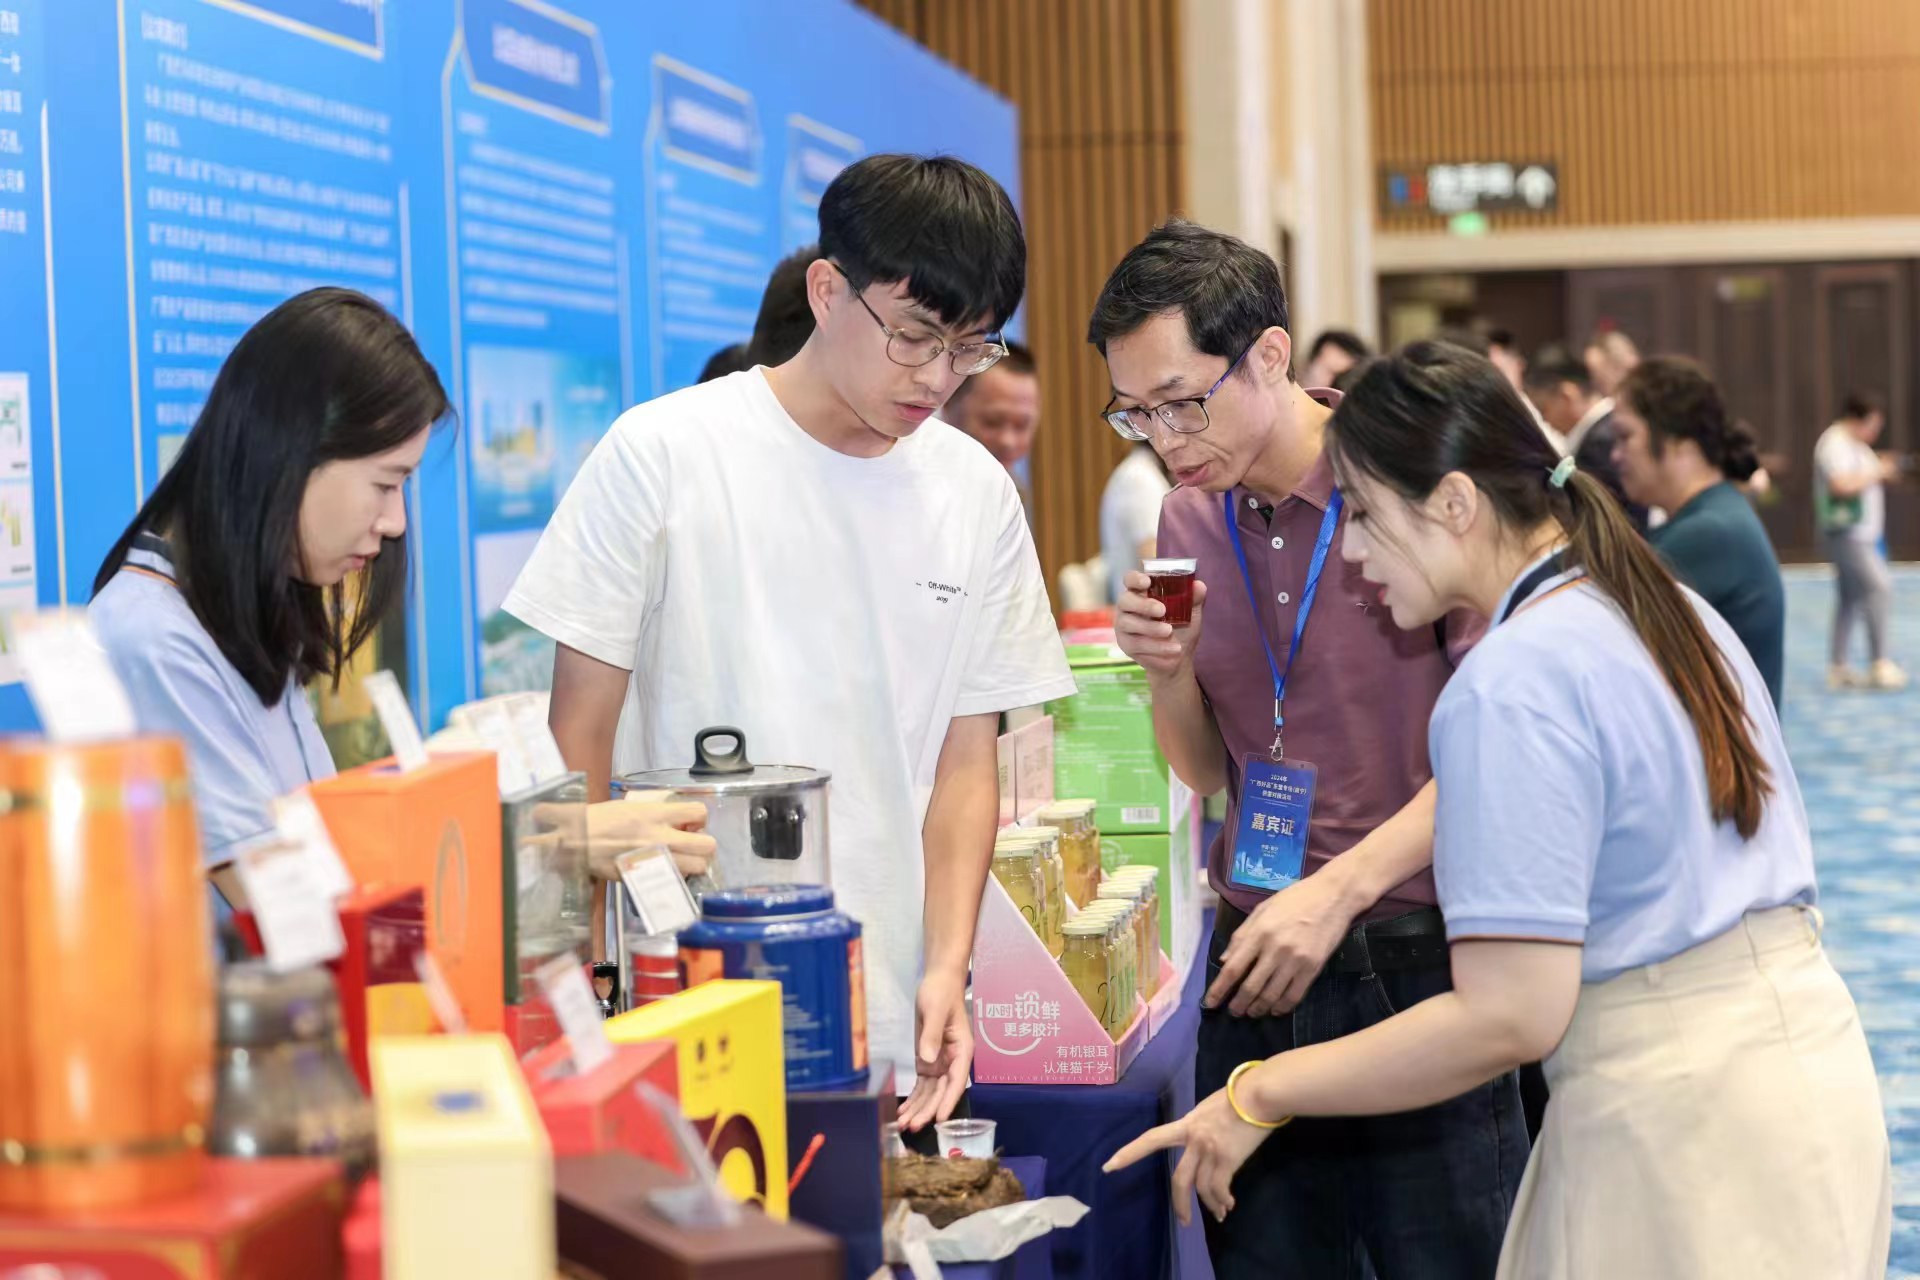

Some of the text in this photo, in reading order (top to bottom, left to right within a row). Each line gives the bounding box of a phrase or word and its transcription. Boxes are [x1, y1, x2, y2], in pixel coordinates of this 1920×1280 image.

[1270, 774, 1288, 782] 2024年
[1251, 812, 1295, 836] 嘉宾证
[975, 991, 1061, 1020] 1小时锁鲜
[1004, 1022, 1061, 1037] 更多胶汁
[1056, 1045, 1109, 1058] 有机银耳
[1043, 1060, 1112, 1074] 认准猫千岁
